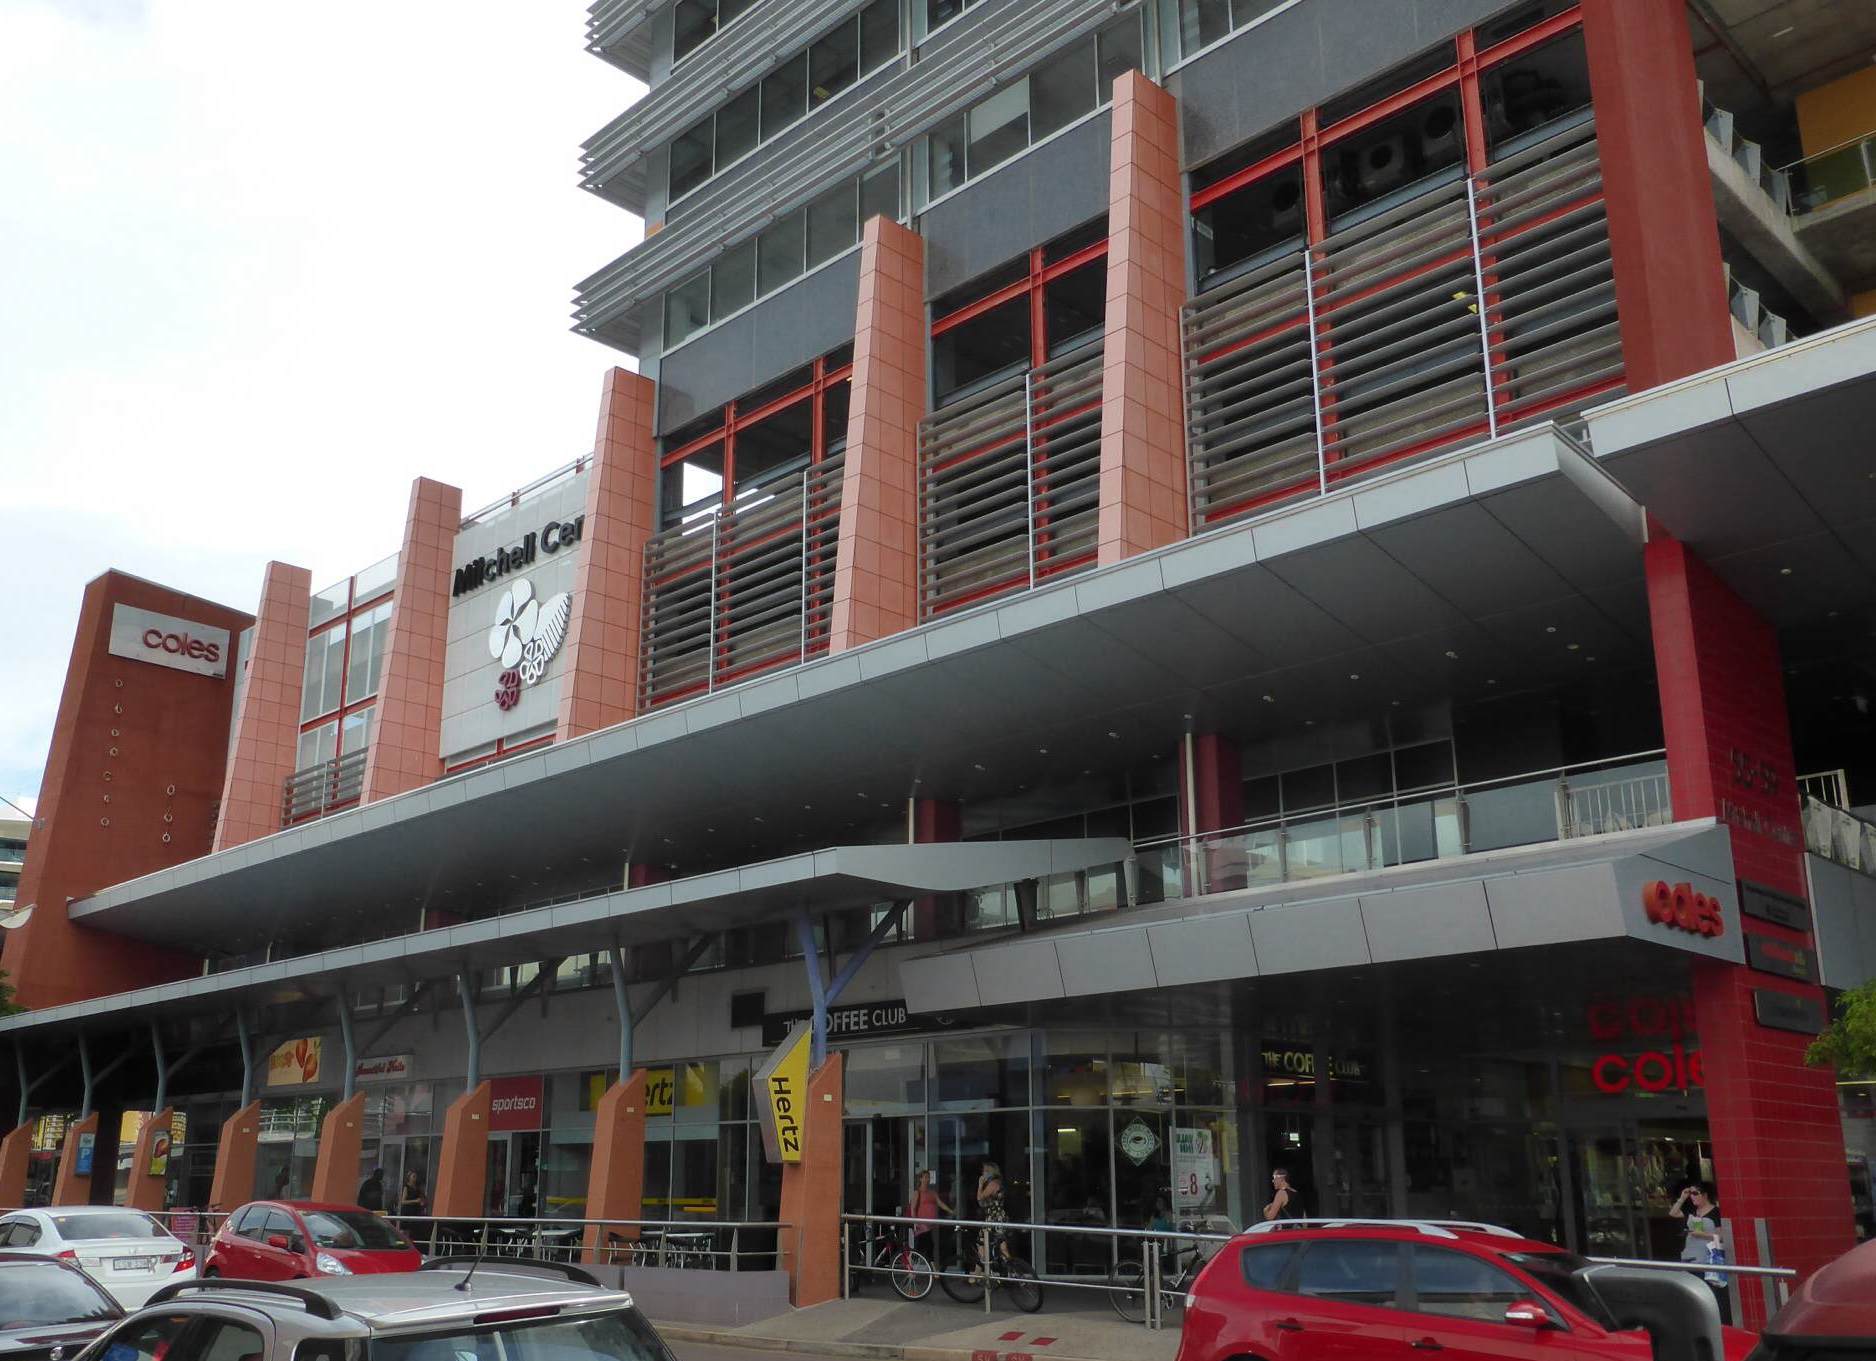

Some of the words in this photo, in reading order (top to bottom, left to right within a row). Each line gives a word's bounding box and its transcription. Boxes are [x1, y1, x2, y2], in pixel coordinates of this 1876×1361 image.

[453, 532, 537, 597] Mitchell
[143, 629, 220, 662] coles
[872, 1008, 906, 1026] CLUB
[1262, 1051, 1281, 1068] THE
[492, 1095, 536, 1114] sportsco
[772, 1077, 799, 1152] Hertz
